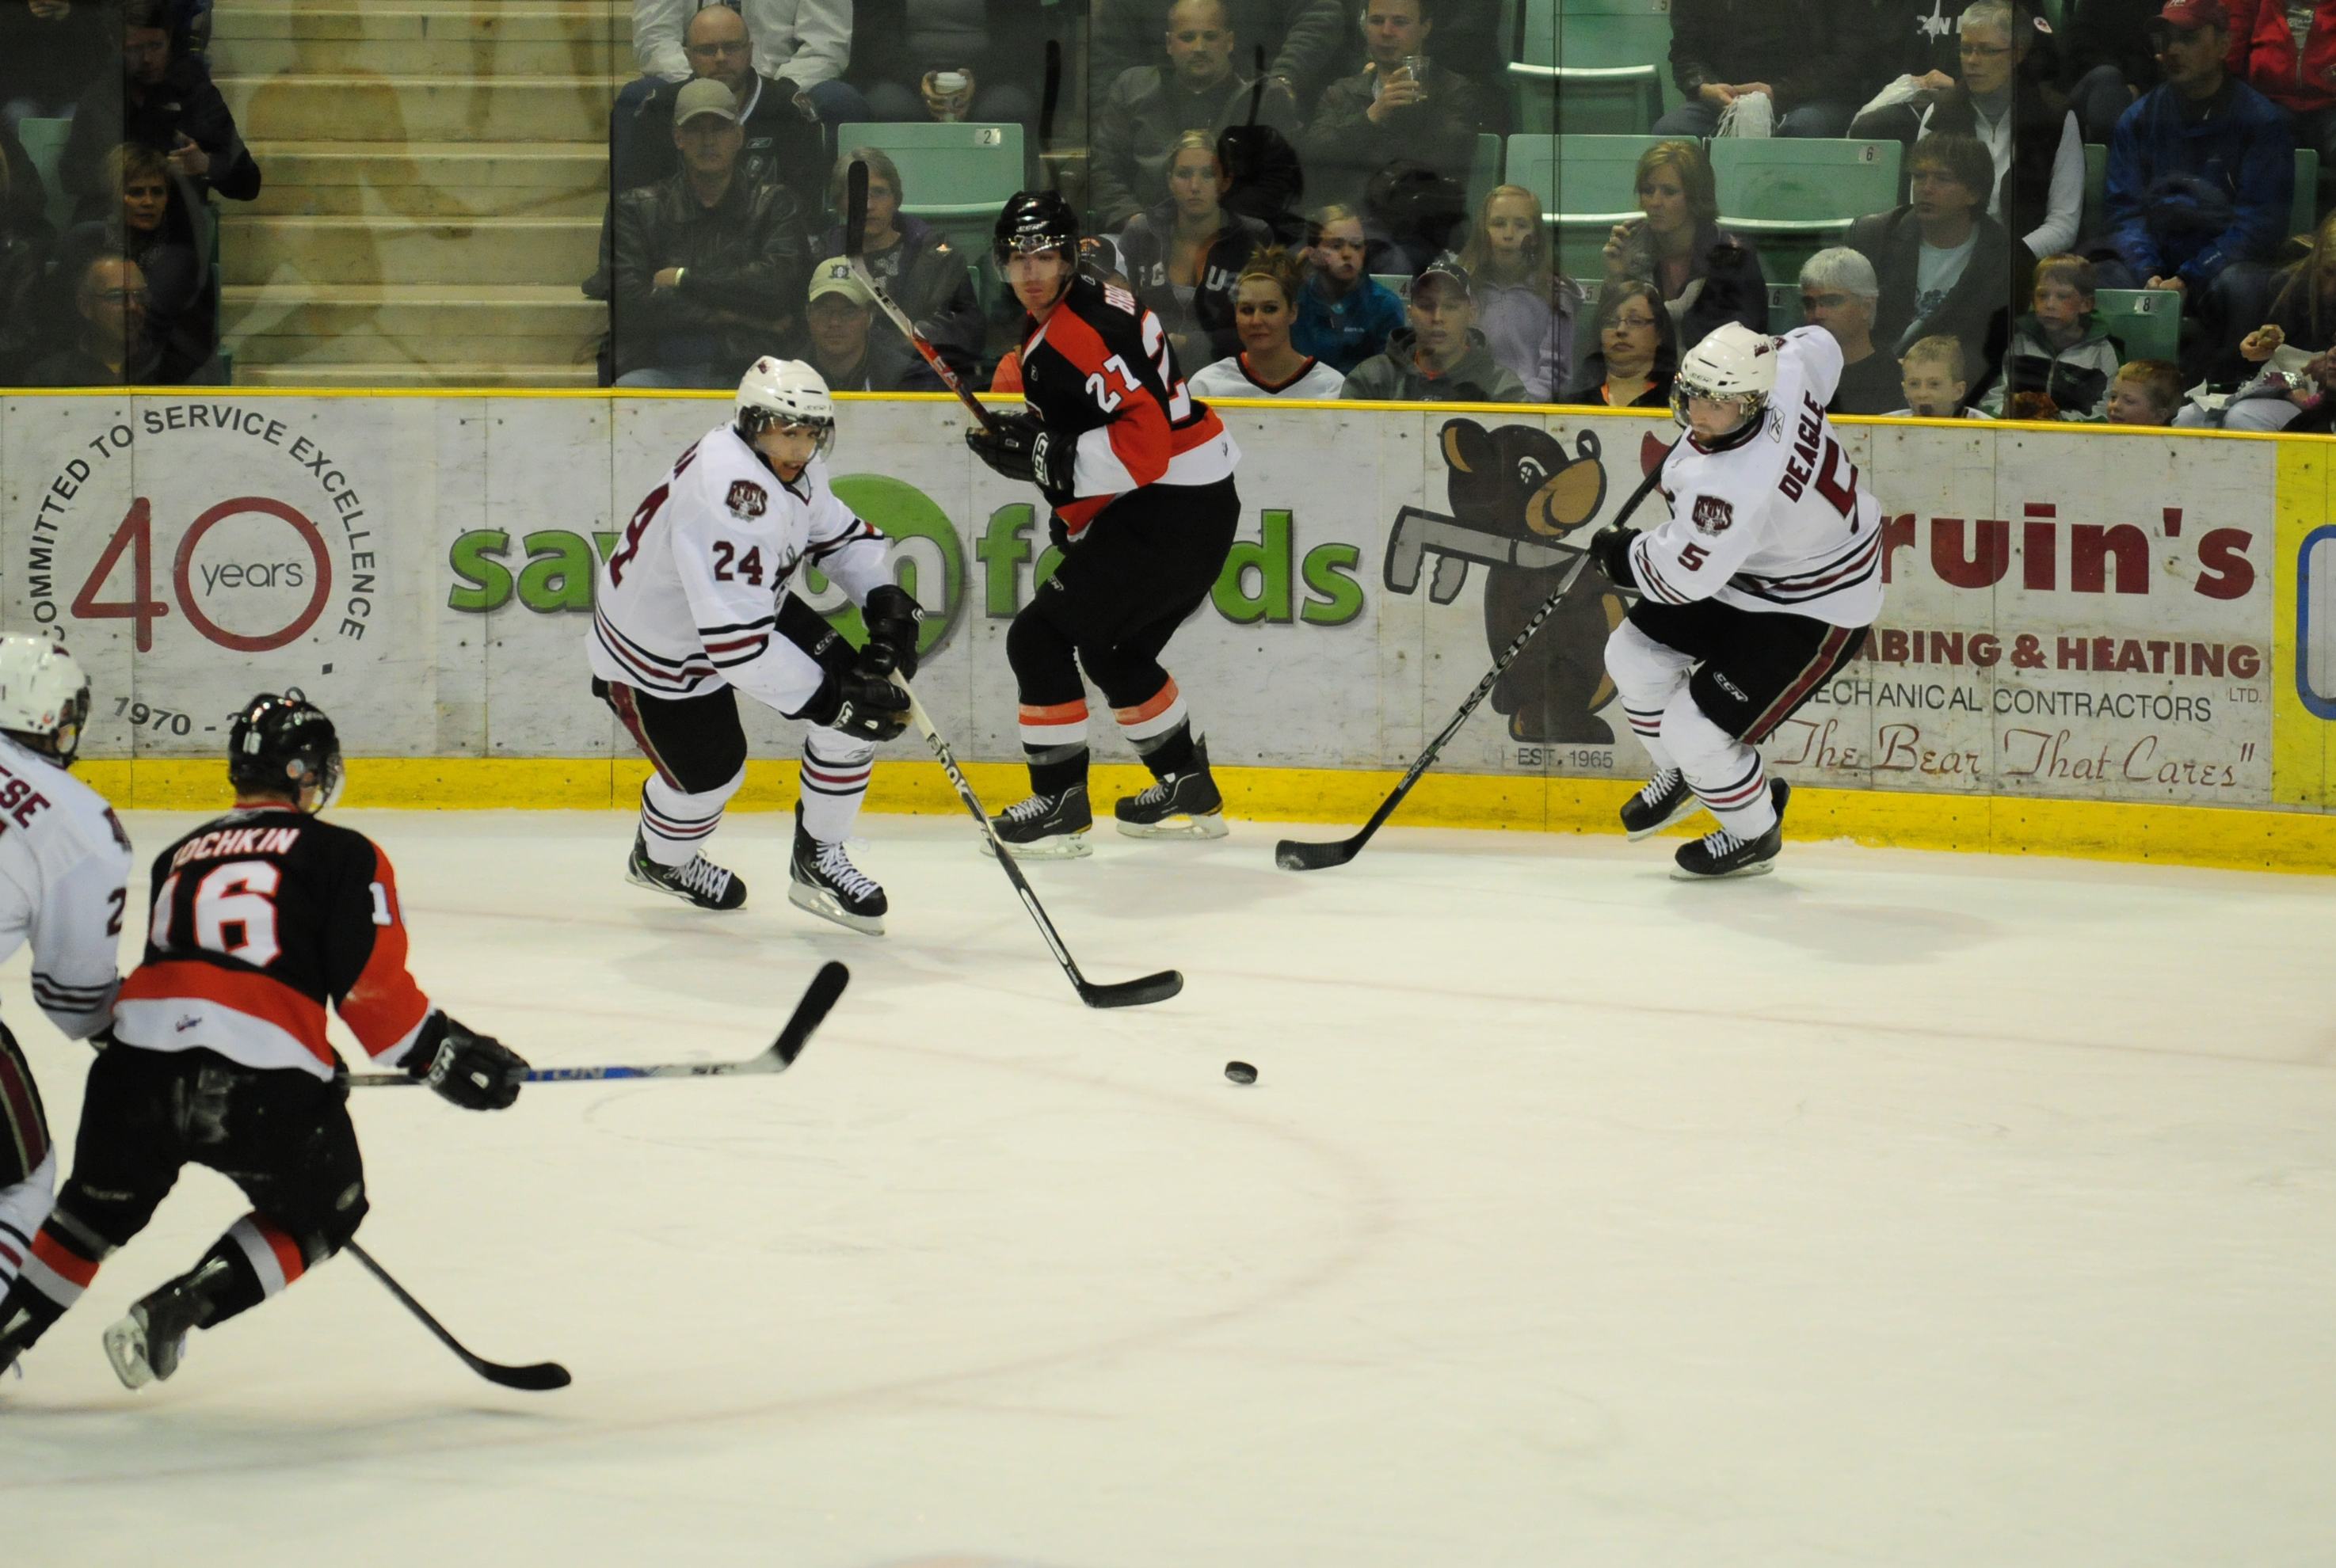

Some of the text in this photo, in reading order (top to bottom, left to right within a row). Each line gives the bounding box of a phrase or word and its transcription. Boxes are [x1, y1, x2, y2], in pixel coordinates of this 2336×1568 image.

[985, 130, 992, 145] 2
[1866, 147, 1874, 162] 6
[1587, 287, 1593, 301] 5
[1773, 291, 1780, 306] 6
[2143, 298, 2151, 313] 8
[1085, 353, 1142, 414] 27
[1778, 390, 1824, 504] DEAGLE
[89, 424, 134, 459] TO
[143, 405, 288, 445] SERVICE
[288, 436, 375, 641] EXCELLENCE
[712, 539, 764, 586] 24
[975, 501, 1364, 627] fds
[1677, 542, 1712, 572] 5
[1881, 501, 2256, 600] ruin's
[70, 496, 332, 653] 40
[200, 561, 303, 597] years
[2010, 634, 2048, 670] &
[2056, 636, 2262, 680] HEATING
[1716, 672, 1745, 701] CCM
[1808, 678, 2212, 722] ECHANICAL CONTRACTORS
[2229, 687, 2262, 703] LTD.
[1569, 750, 1614, 769] 1965
[1871, 723, 1981, 774] Bear
[2003, 728, 2112, 779] That
[169, 828, 300, 873] OCHKIN
[106, 886, 127, 937] 2
[151, 860, 281, 969] 16
